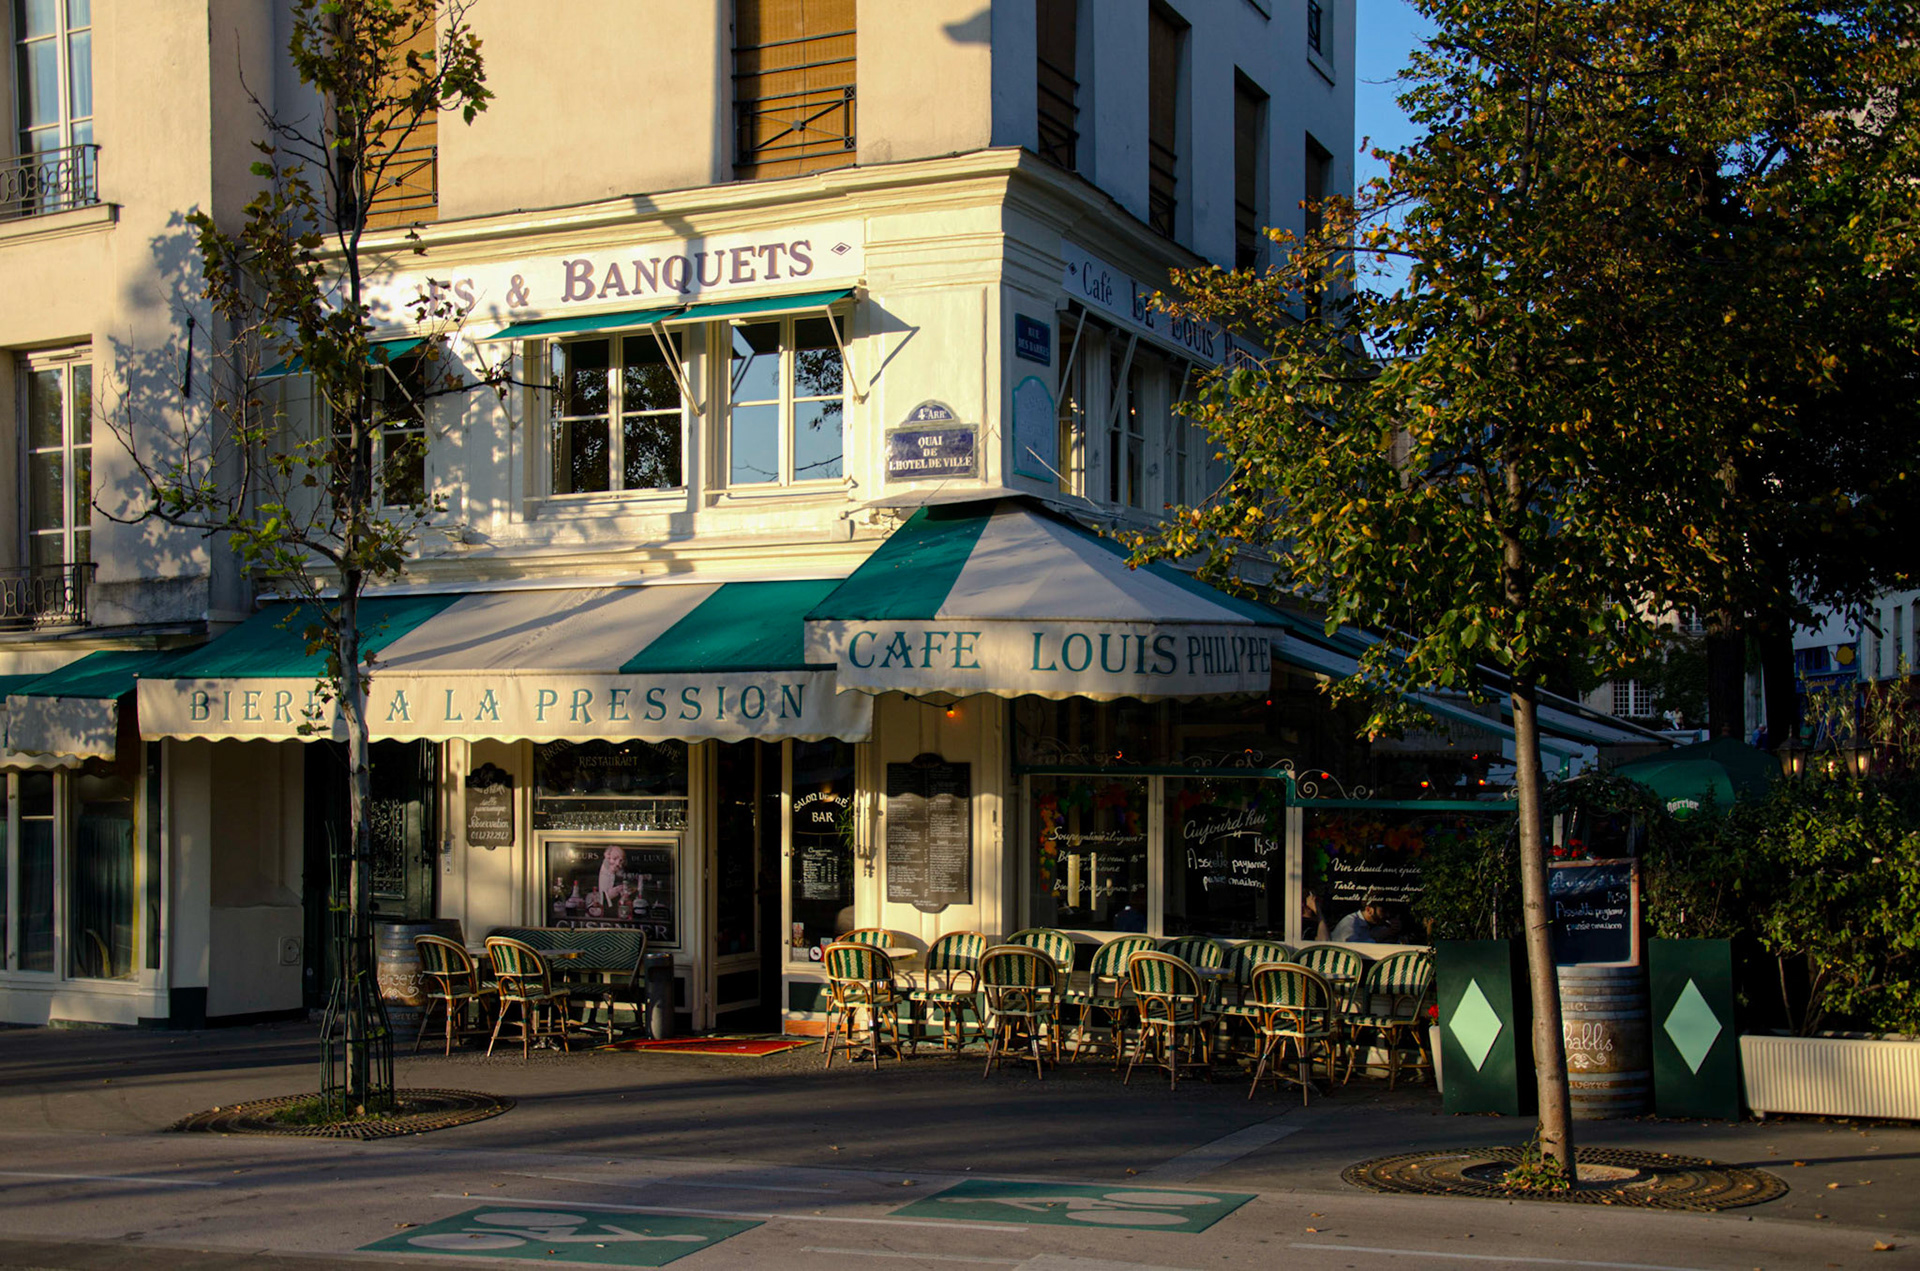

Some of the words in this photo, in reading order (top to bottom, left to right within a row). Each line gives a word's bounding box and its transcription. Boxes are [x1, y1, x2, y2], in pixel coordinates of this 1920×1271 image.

[506, 274, 530, 308] &
[561, 240, 814, 302] BANQUETS
[1083, 261, 1113, 306] Café
[918, 436, 942, 448] QUAI
[923, 449, 938, 457] DE
[928, 460, 942, 468] DE
[943, 457, 972, 468] VILLE
[848, 631, 981, 669] CAFE
[1032, 632, 1177, 675] LOUIS
[190, 690, 347, 725] BIERE
[386, 690, 414, 723] A
[445, 689, 502, 723] LA
[535, 684, 805, 725] PRESSION
[812, 811, 834, 823] BAR
[1331, 857, 1352, 872] Vin
[1354, 860, 1383, 873] chaud
[1334, 881, 1356, 890] Tarte
[1563, 1022, 1613, 1051] hablis
